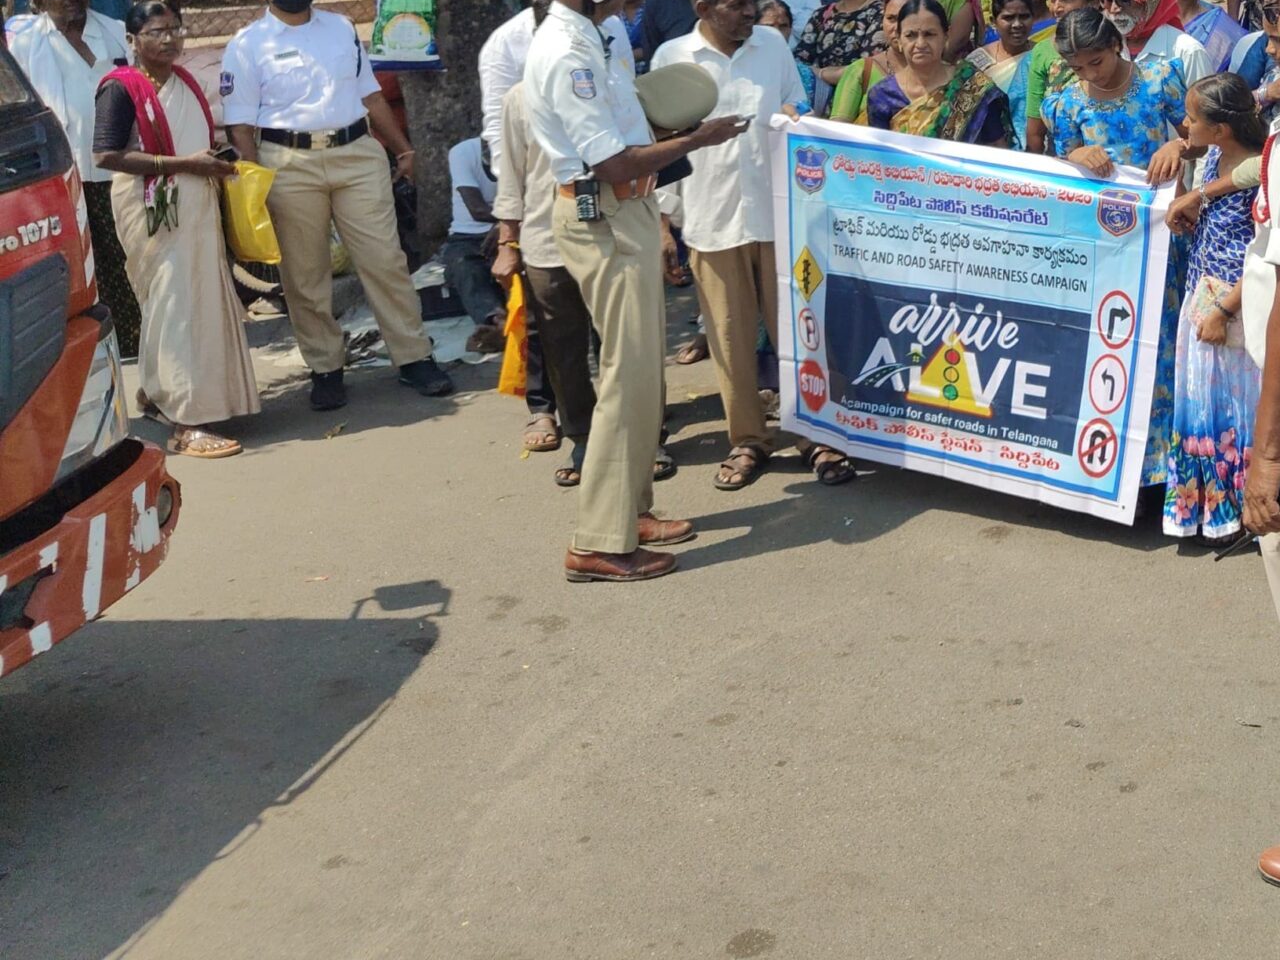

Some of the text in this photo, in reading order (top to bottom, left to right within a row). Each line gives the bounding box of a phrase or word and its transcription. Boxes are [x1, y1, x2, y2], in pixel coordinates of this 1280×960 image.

[1102, 204, 1130, 213] POLICE
[17, 215, 62, 246] 1075
[833, 244, 1088, 293] TRAFFIC AND ROAD SAFETY AWARENESS CAMPAIGN
[888, 292, 1019, 350] arrive
[800, 373, 826, 396] STOP
[906, 406, 923, 419] for
[924, 409, 952, 427] safer
[954, 419, 985, 434] roads
[987, 424, 998, 437] in
[1000, 426, 1059, 449] Telangana
